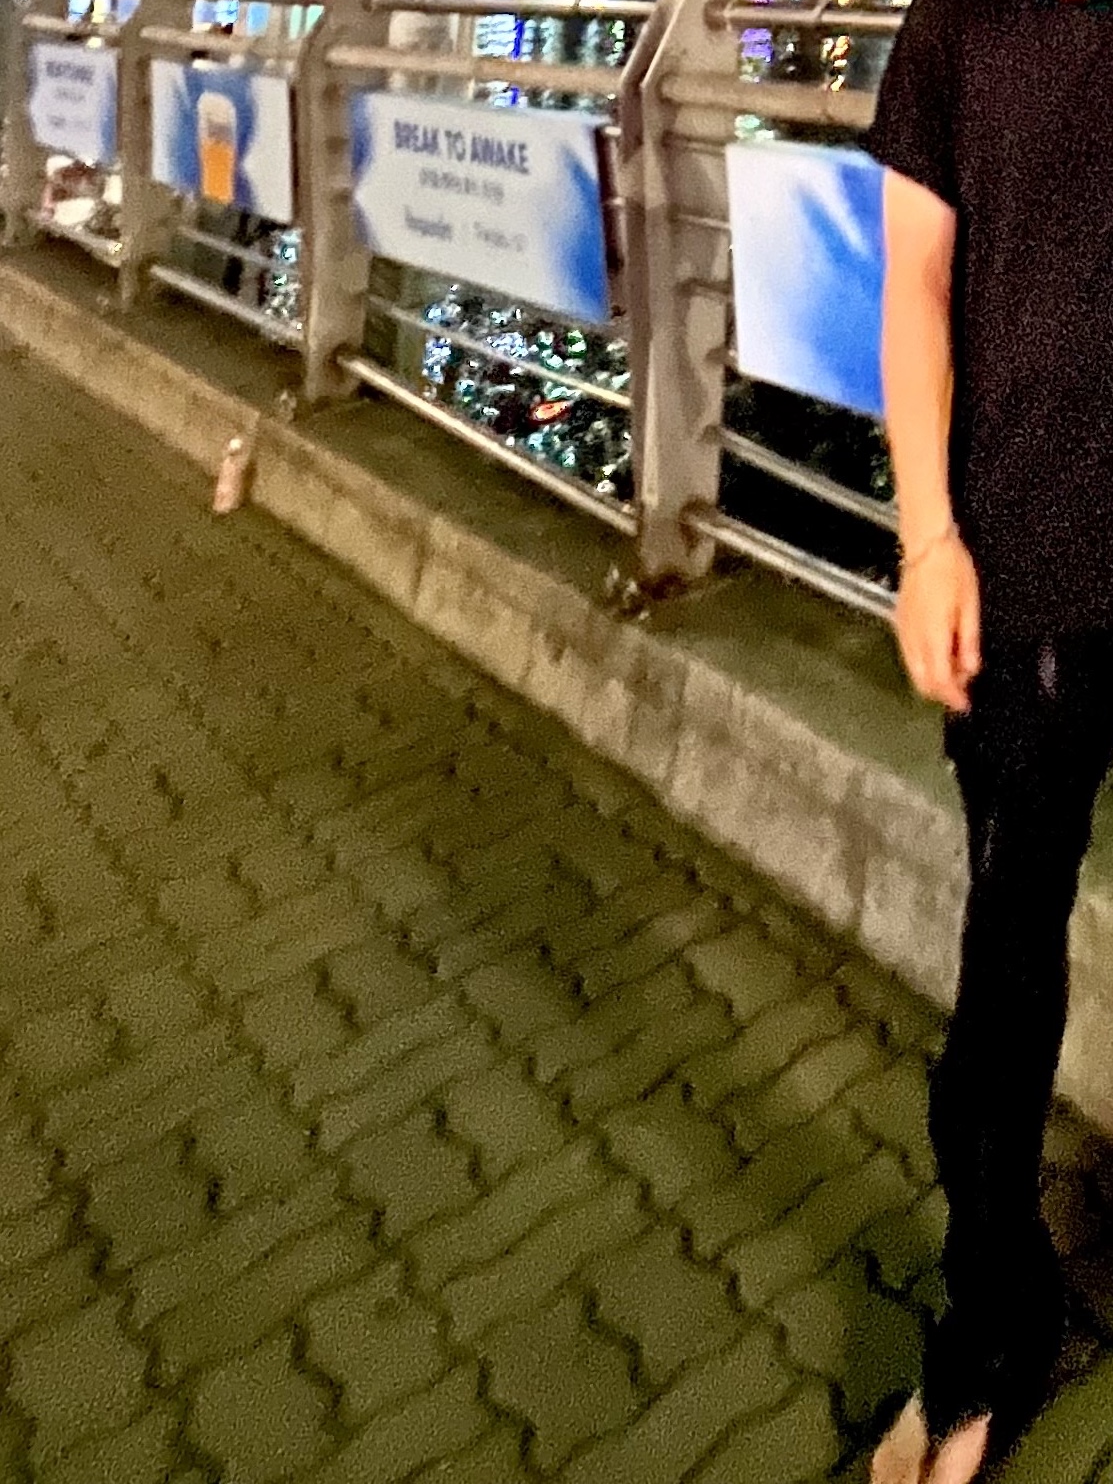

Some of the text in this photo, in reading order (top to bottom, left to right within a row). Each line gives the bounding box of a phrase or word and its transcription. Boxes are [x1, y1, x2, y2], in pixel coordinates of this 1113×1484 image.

[394, 119, 530, 175] BREAK TO AWAKE
